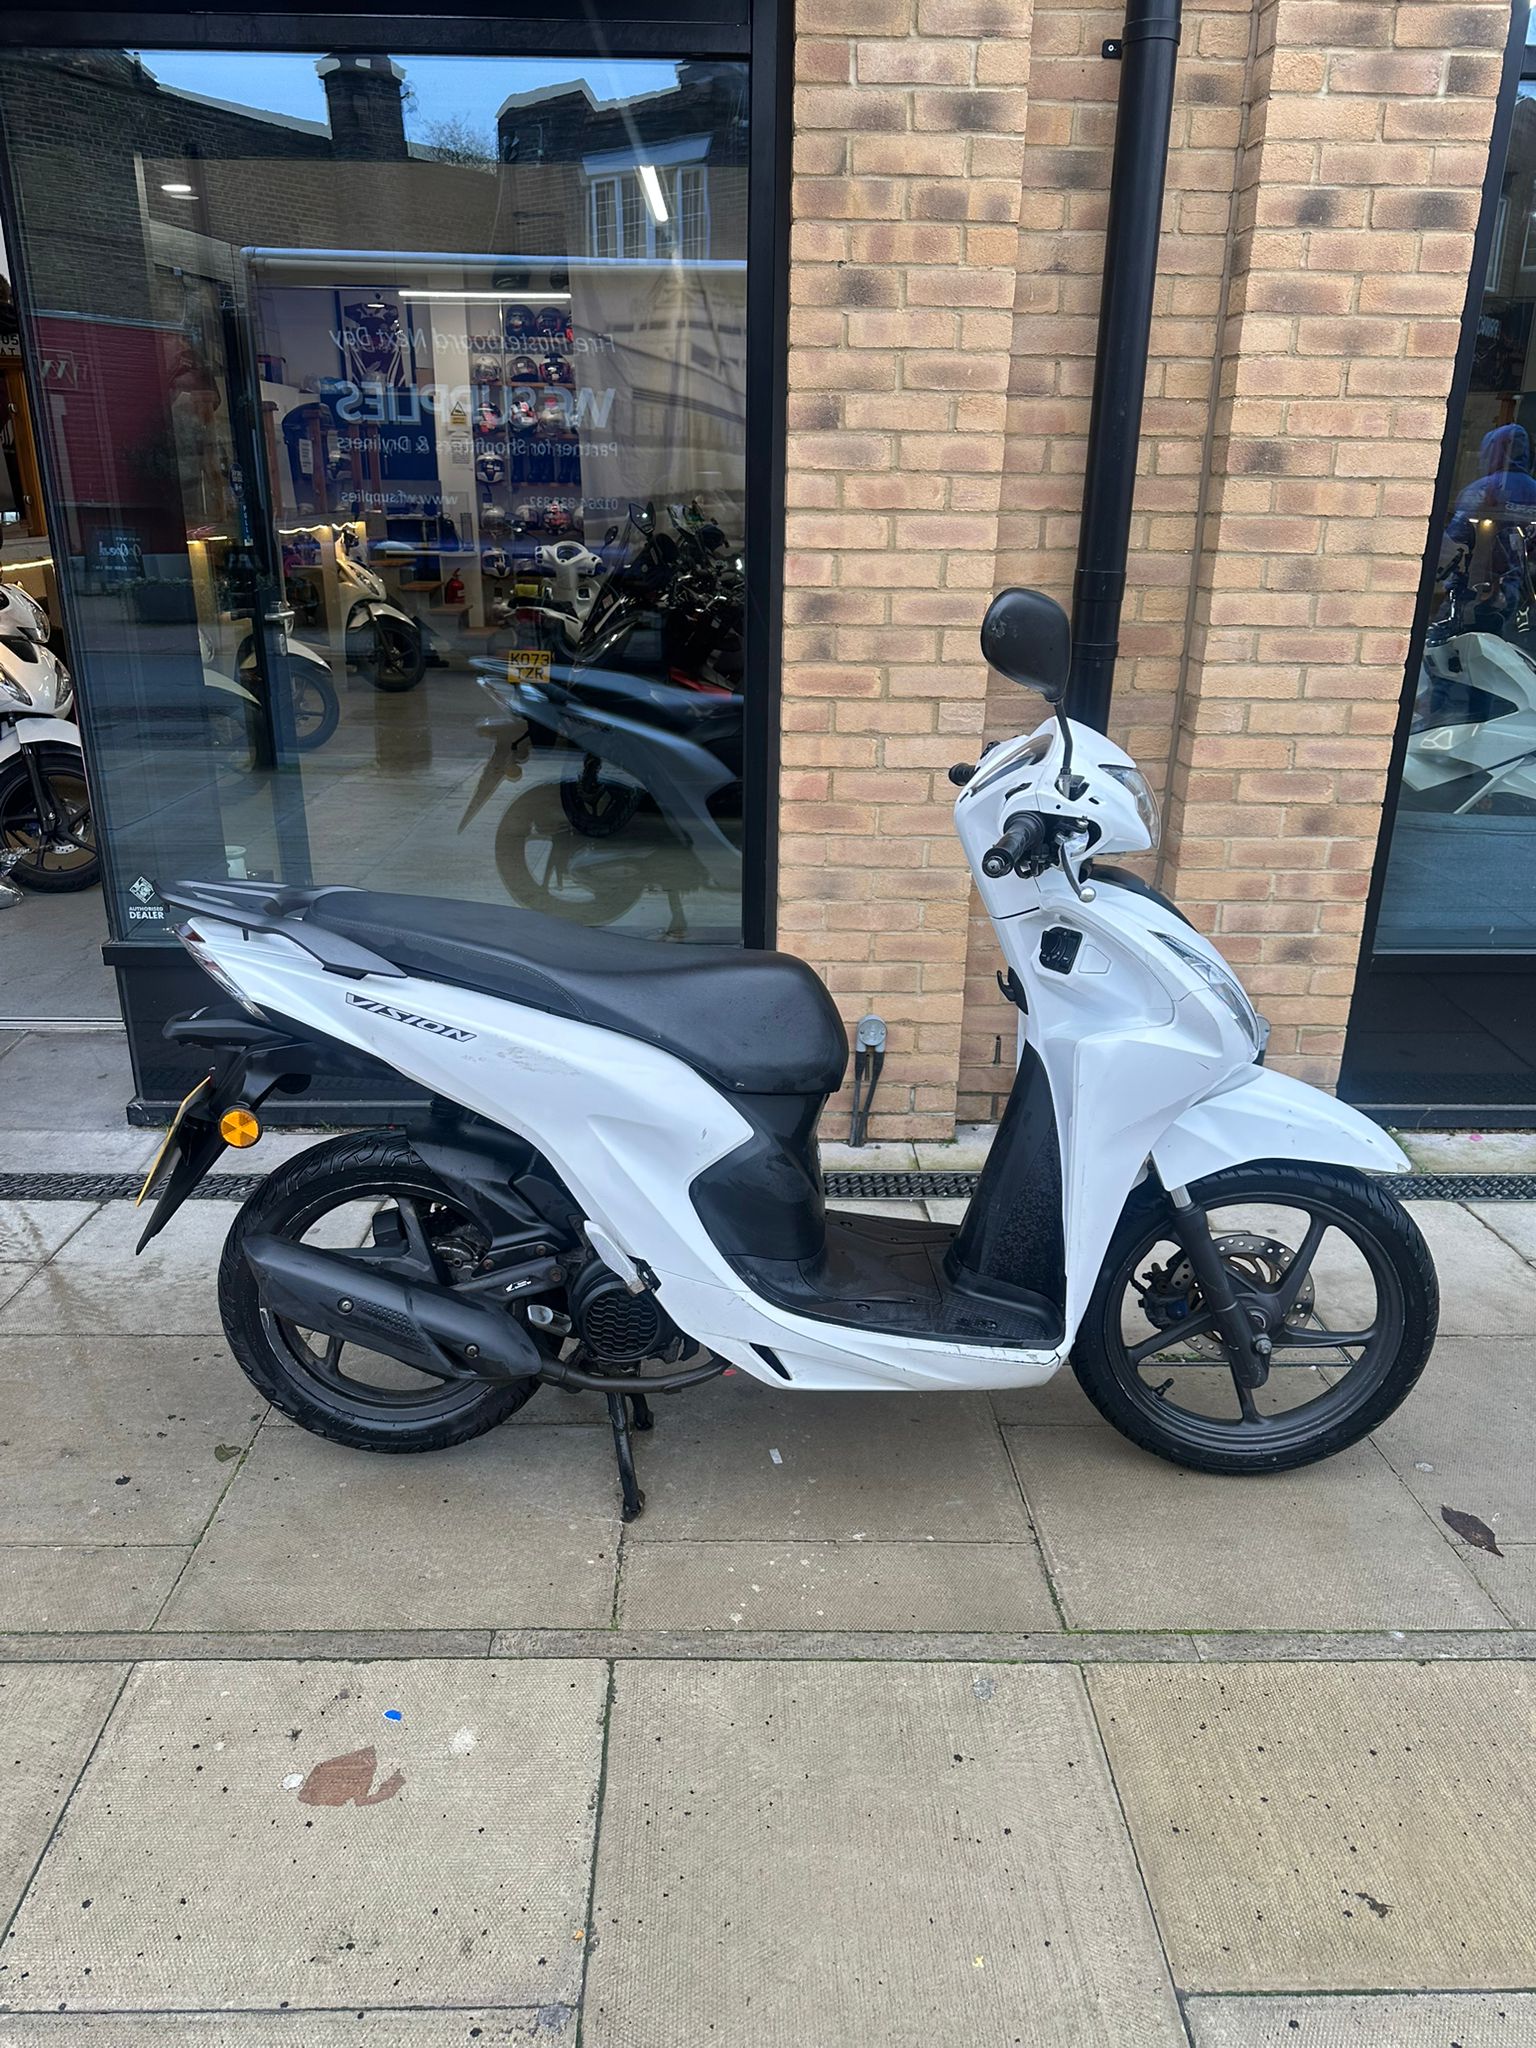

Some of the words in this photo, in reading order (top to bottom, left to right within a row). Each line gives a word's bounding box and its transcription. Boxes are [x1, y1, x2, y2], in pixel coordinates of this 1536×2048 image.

[510, 653, 550, 666] KO73
[515, 667, 545, 680] TZR
[129, 911, 165, 920] DEALER
[346, 992, 476, 1042] VISION
